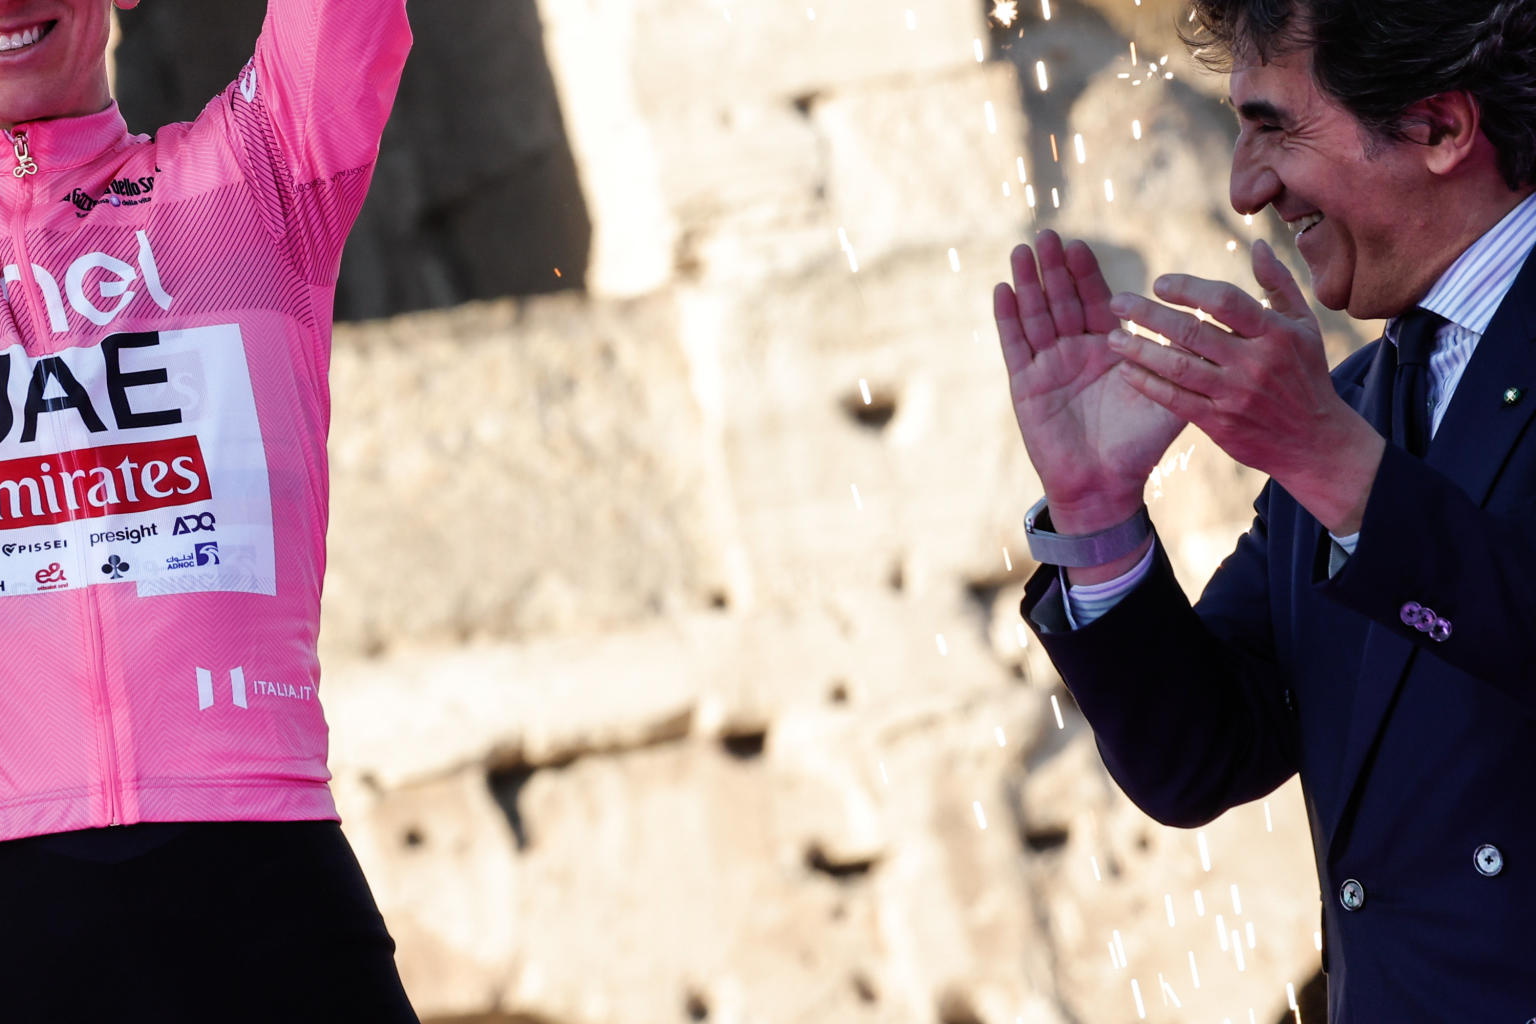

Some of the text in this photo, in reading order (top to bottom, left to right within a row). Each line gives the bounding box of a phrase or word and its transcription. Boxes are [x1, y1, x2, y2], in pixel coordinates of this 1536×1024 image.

[18, 540, 68, 554] PISSEI
[90, 523, 159, 547] presight
[172, 511, 216, 536] ADQ
[167, 561, 195, 570] ADNOC
[253, 680, 312, 701] ITALIA.IT
